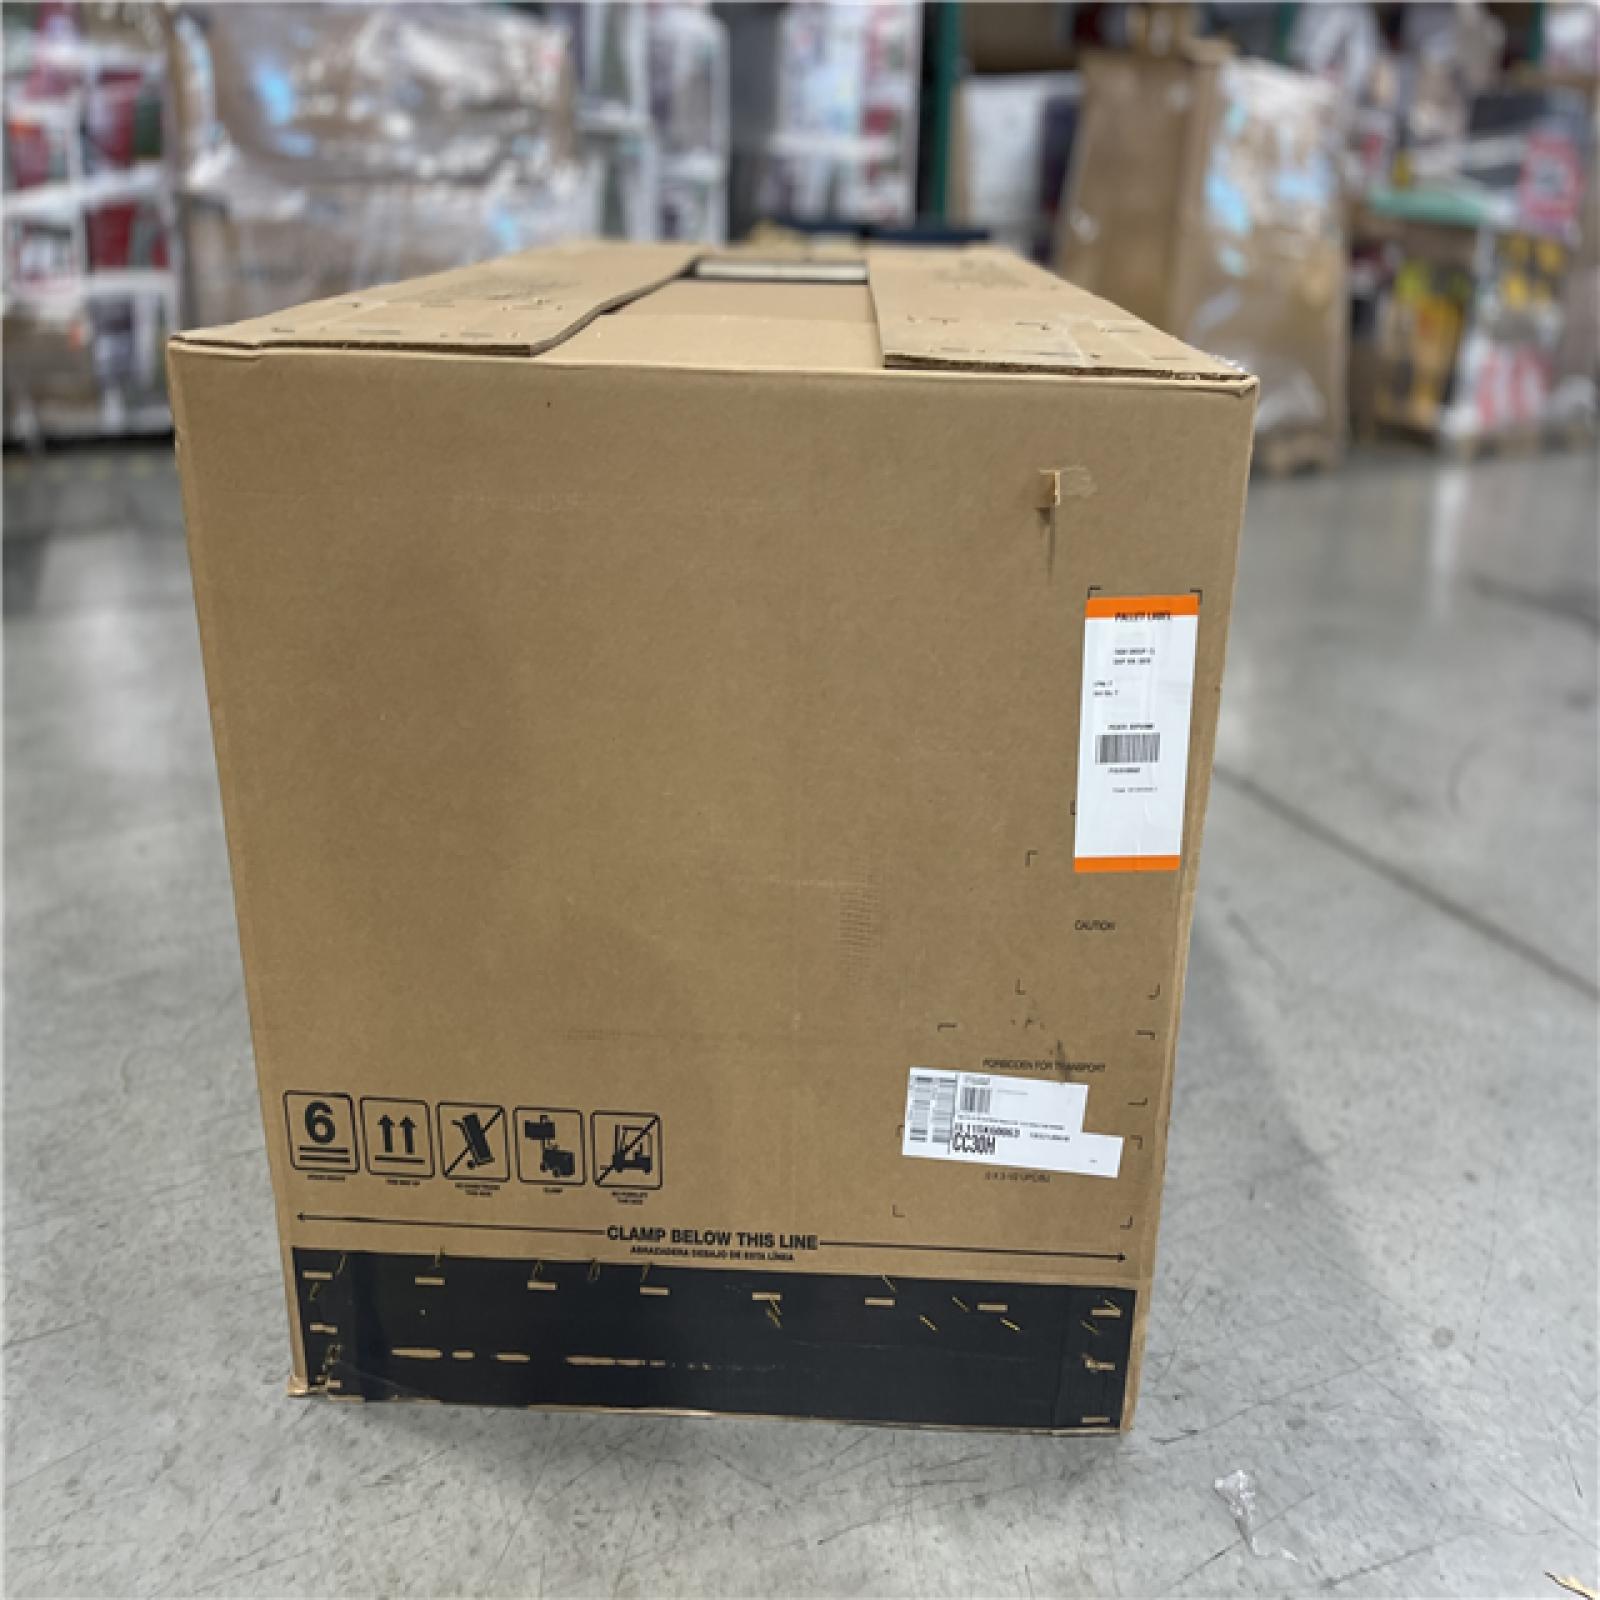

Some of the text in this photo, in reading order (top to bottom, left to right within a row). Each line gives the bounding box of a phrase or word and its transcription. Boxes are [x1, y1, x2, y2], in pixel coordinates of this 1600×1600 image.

[1075, 920, 1116, 931] CAUTION
[1035, 1060, 1053, 1071] FOR
[305, 1100, 336, 1144] 6
[607, 1225, 818, 1250] CLAMP BELOW THIS LINE
